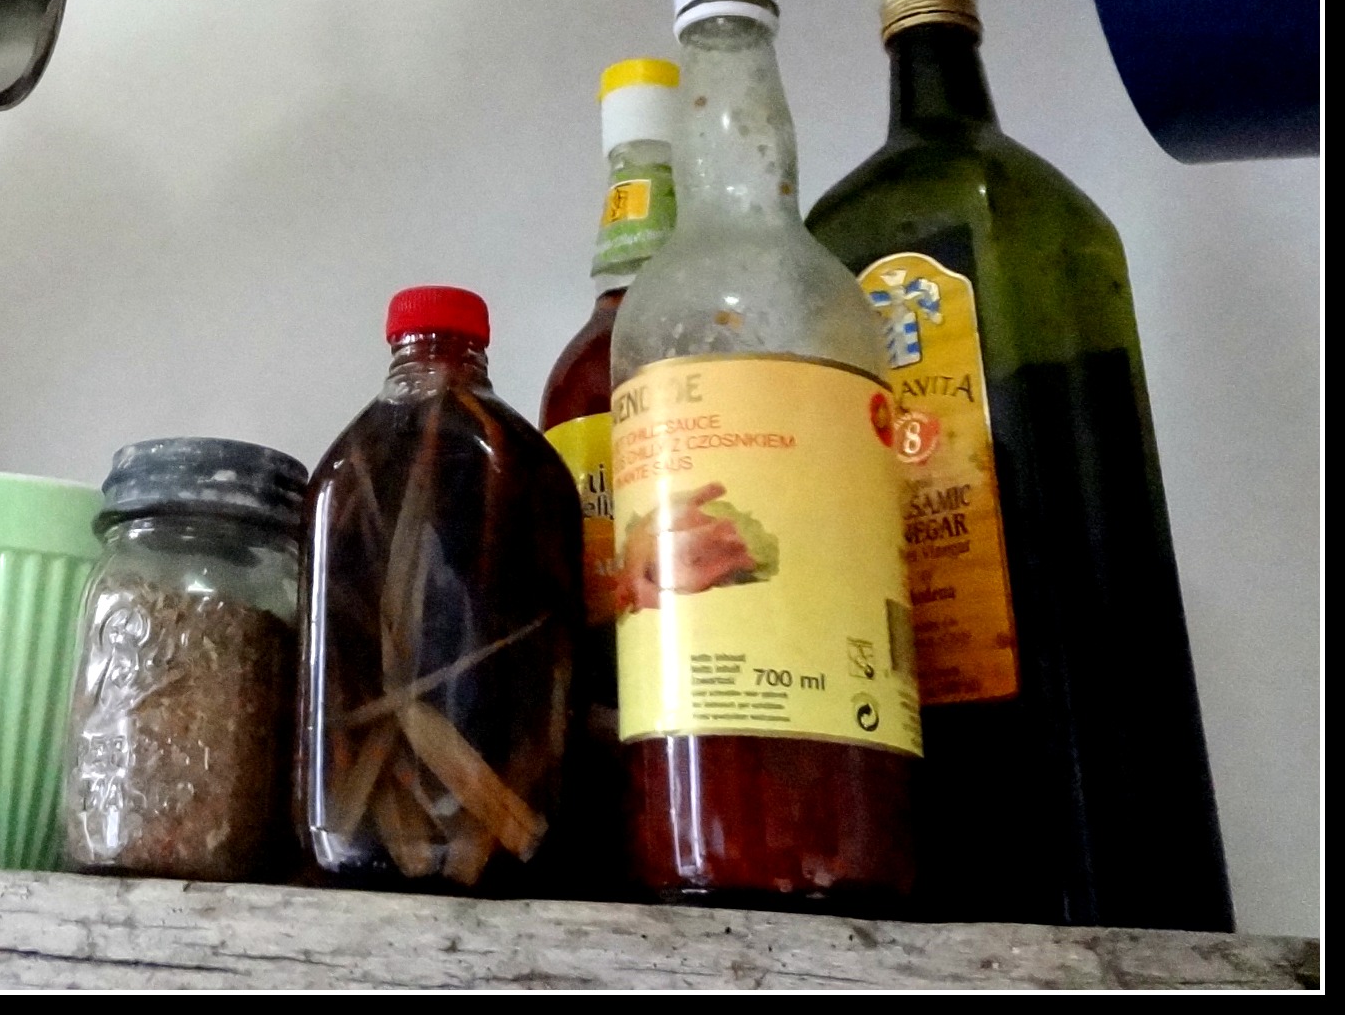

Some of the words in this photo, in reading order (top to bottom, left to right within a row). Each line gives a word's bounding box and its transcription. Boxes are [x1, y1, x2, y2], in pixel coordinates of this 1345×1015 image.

[902, 373, 974, 403] AVITA
[665, 414, 721, 434] SAUCE
[904, 421, 922, 454] 8
[905, 484, 971, 518] SAMIC
[753, 669, 793, 687] 700
[800, 674, 825, 690] ml
